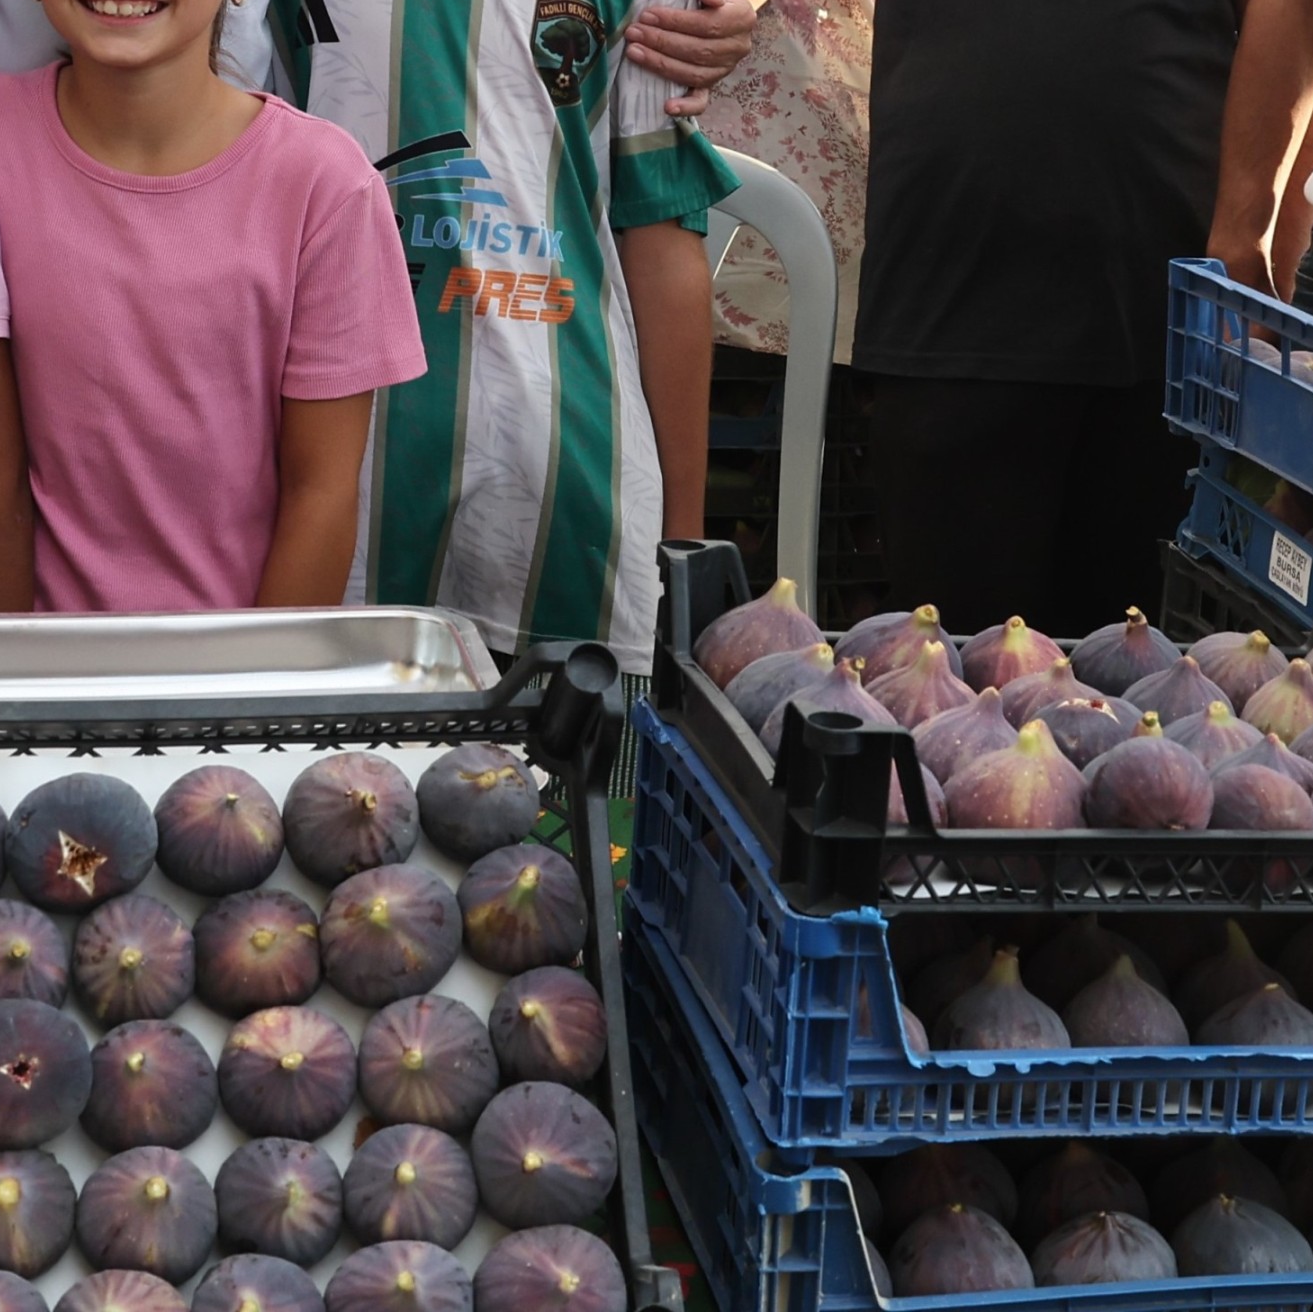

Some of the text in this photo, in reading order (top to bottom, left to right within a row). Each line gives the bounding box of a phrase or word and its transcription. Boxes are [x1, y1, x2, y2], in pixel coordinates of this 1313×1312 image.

[410, 213, 565, 263] LOJİSTİK
[437, 267, 576, 324] PRES
[1276, 555, 1301, 583] BURSA
